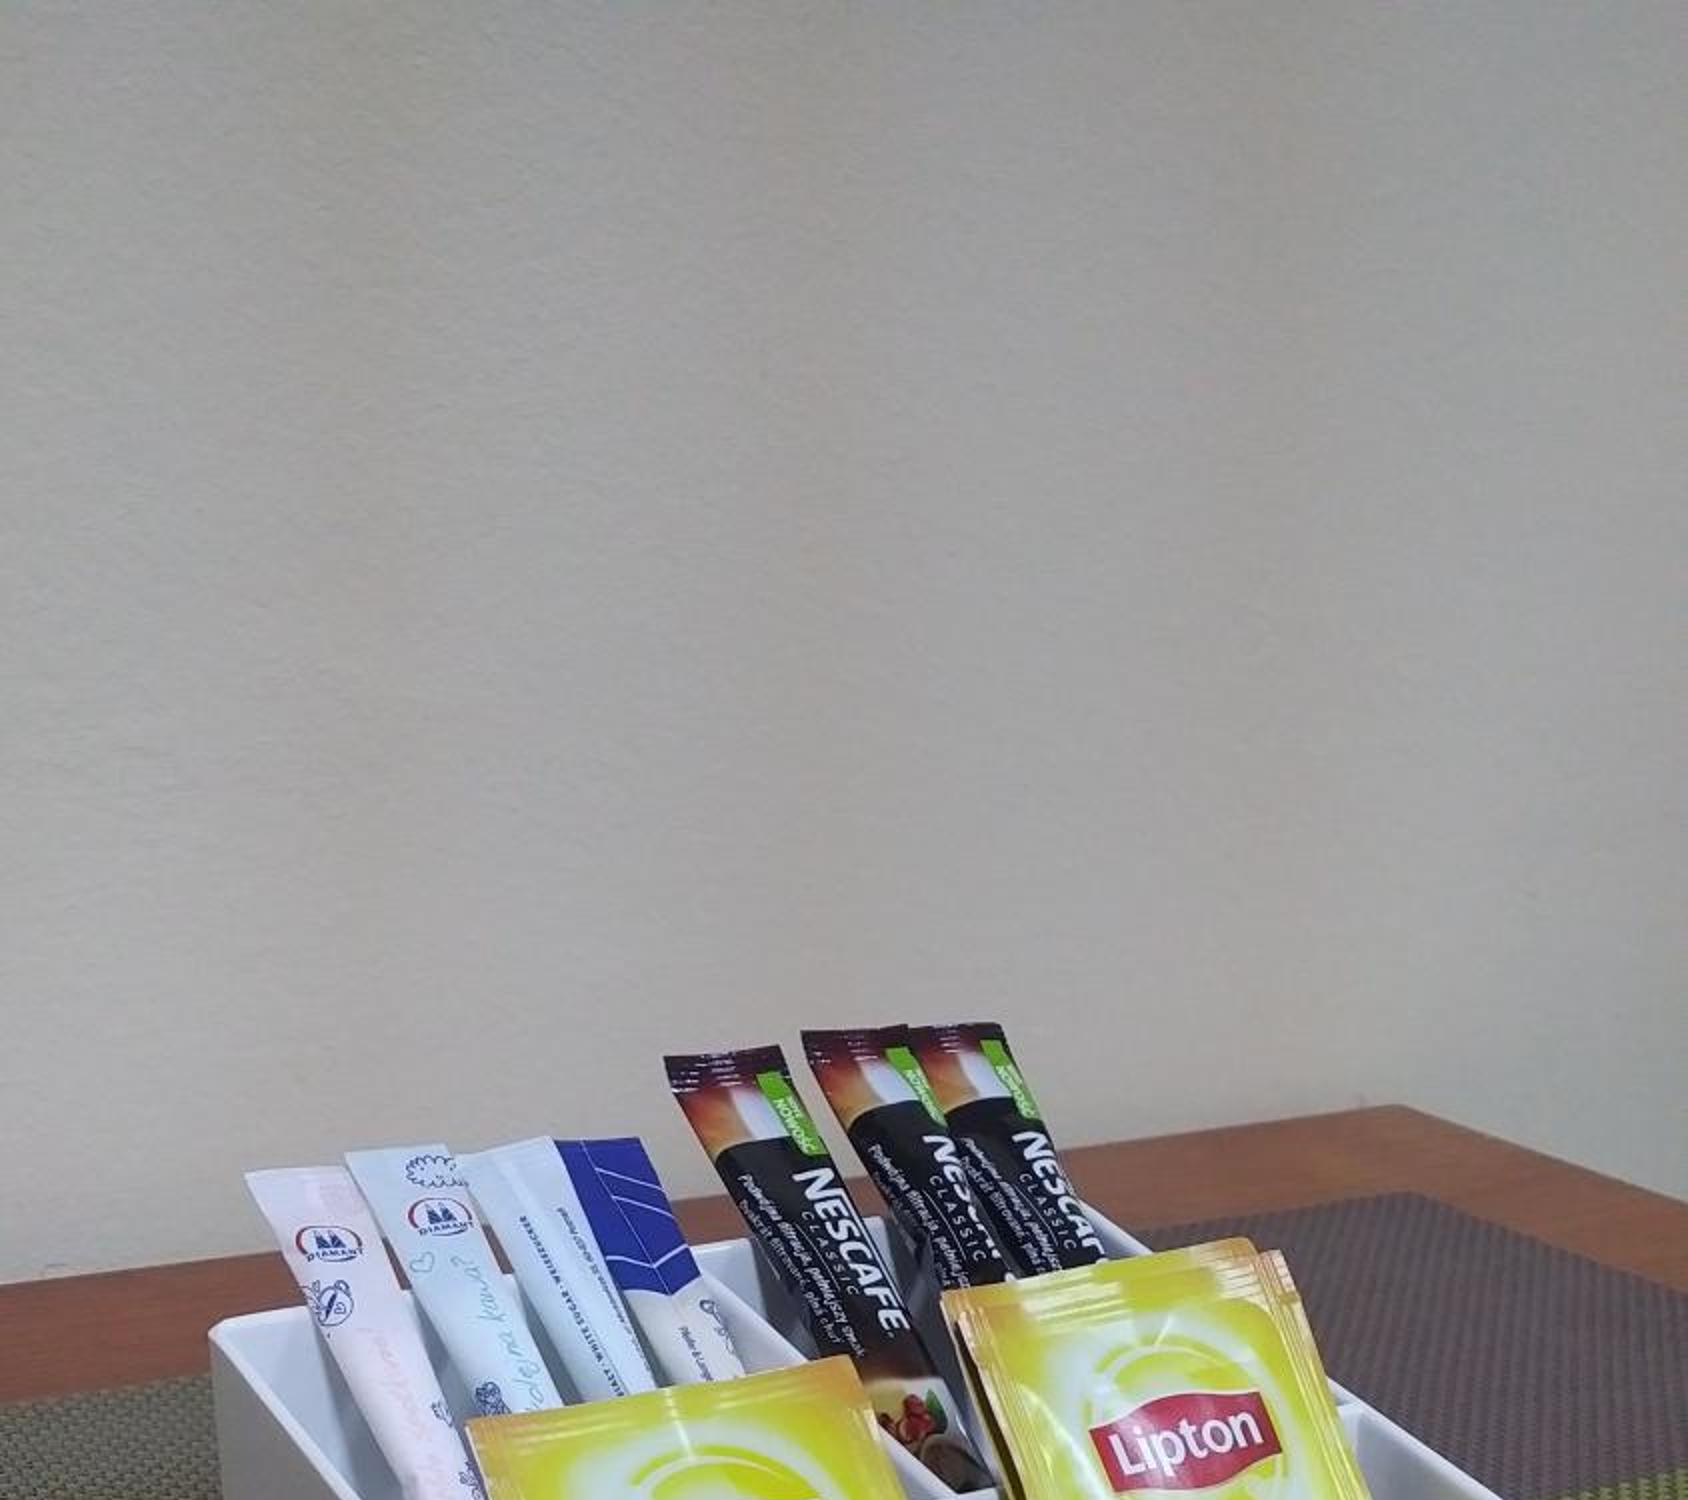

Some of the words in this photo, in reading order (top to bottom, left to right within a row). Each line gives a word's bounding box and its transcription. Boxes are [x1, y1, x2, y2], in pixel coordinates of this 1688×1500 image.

[418, 1221, 475, 1236] DIAMANT
[929, 1175, 987, 1261] CLASSIC
[1019, 1173, 1077, 1249] CLASSIC
[306, 1247, 364, 1263] DIAMANT
[801, 1211, 859, 1296] CLASSIC
[561, 1290, 585, 1326] SUGAR
[580, 1326, 604, 1363] WHITE
[1109, 1410, 1264, 1477] Lipton
